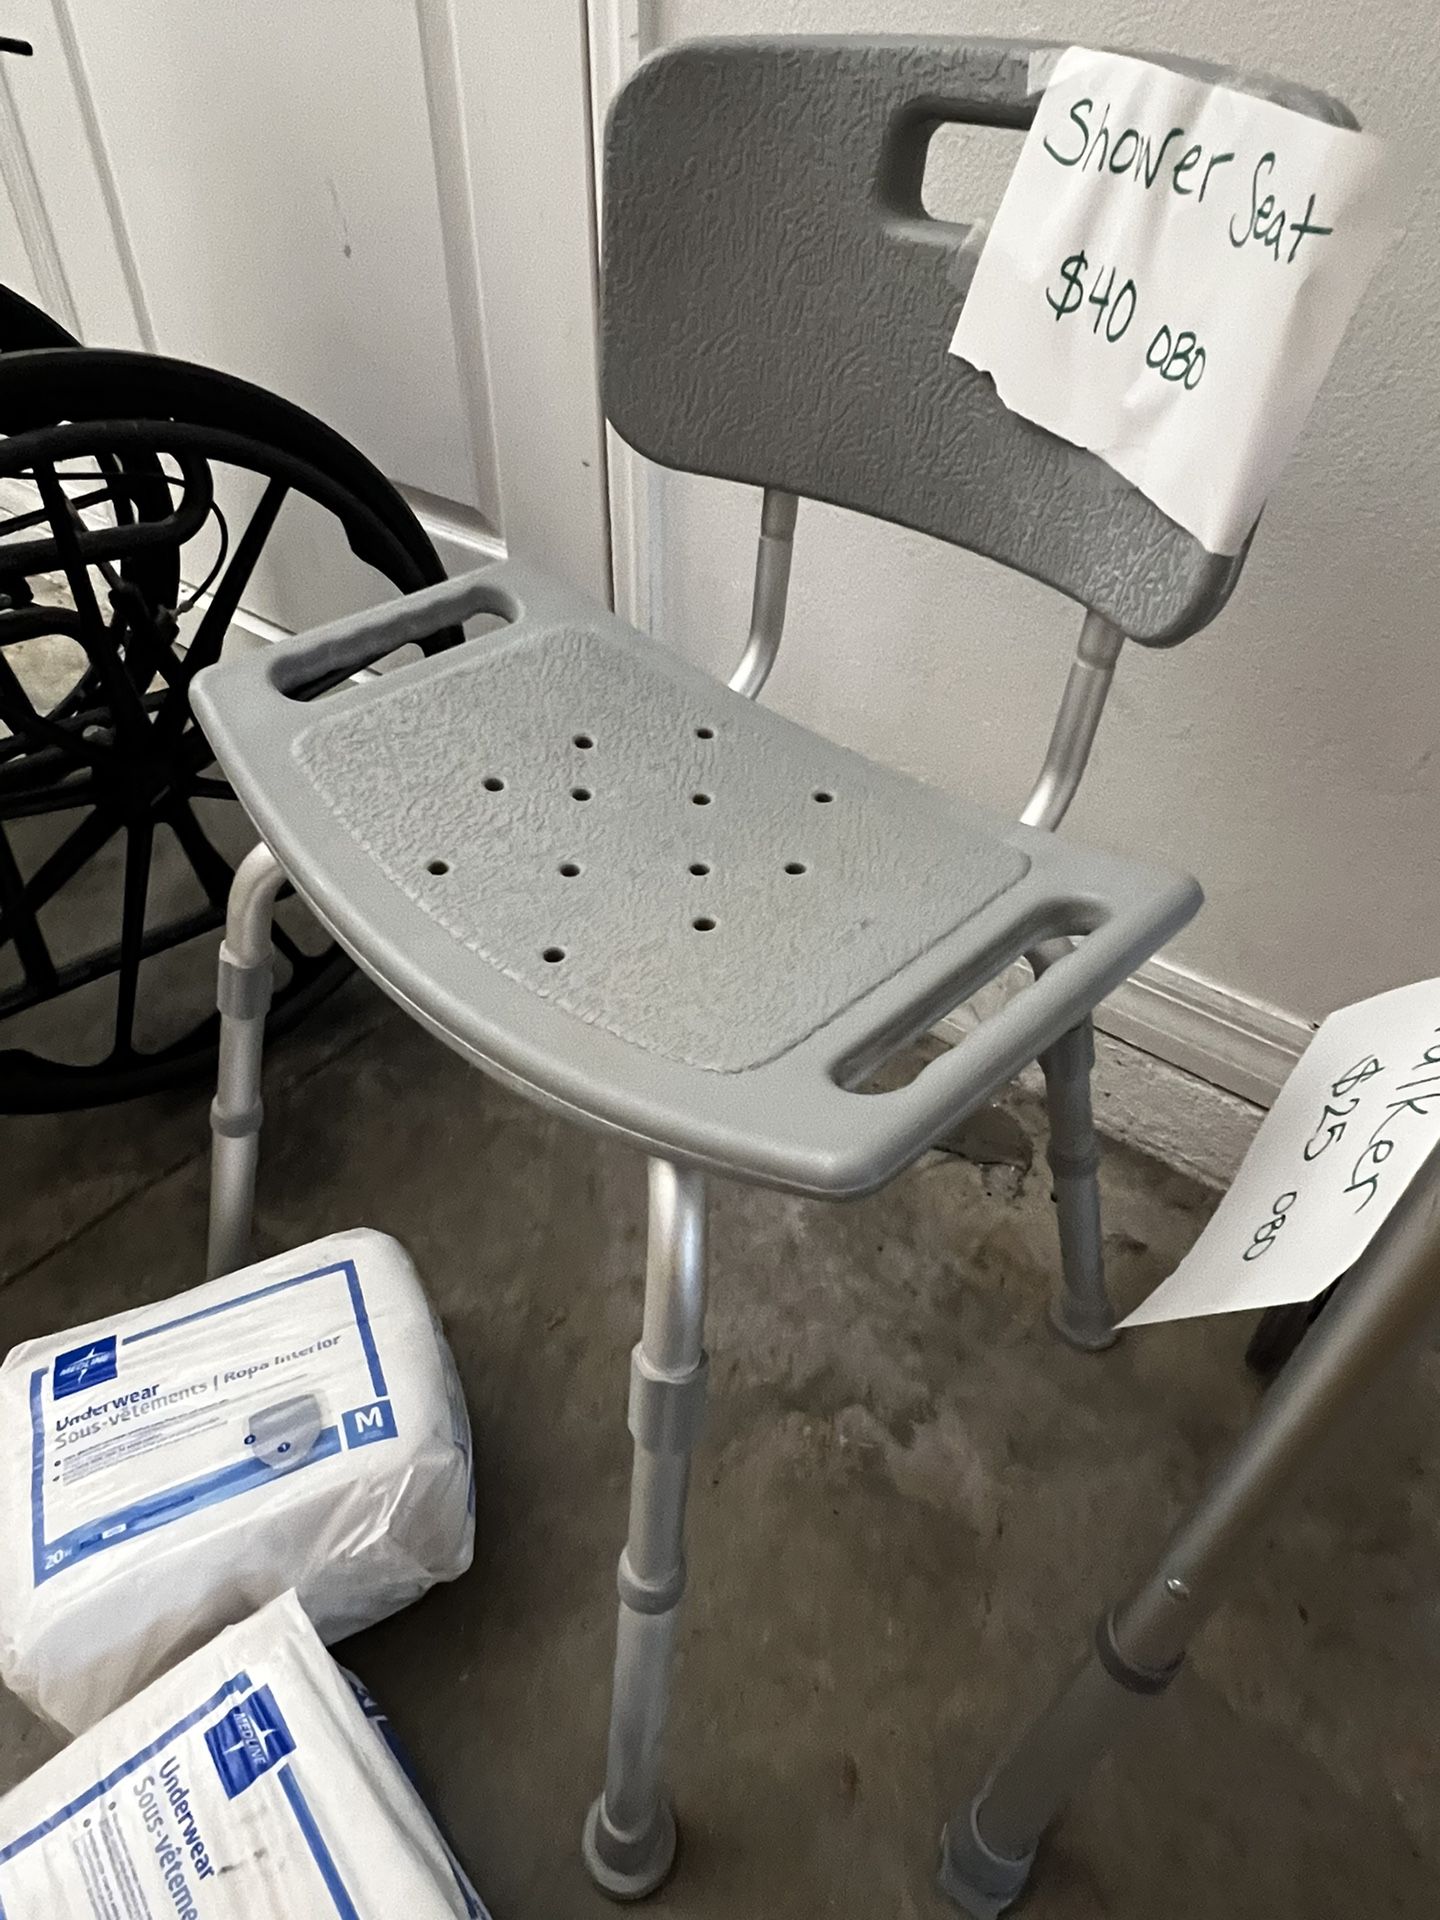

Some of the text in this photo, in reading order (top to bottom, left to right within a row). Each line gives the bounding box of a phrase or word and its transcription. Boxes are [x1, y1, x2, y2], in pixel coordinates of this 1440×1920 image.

[1043, 98, 1334, 263] Shower Seat
[1046, 250, 1207, 390] $40 OBO
[1242, 1054, 1386, 1261] $25 OBO
[1343, 1027, 1440, 1215] alker
[54, 1381, 208, 1451] Sous-vêtements
[223, 1362, 270, 1384] Ropa
[56, 1383, 161, 1432] Underwear
[354, 1406, 384, 1433] M
[233, 1712, 268, 1766] MEDLINE
[159, 1756, 215, 1880] Underwear
